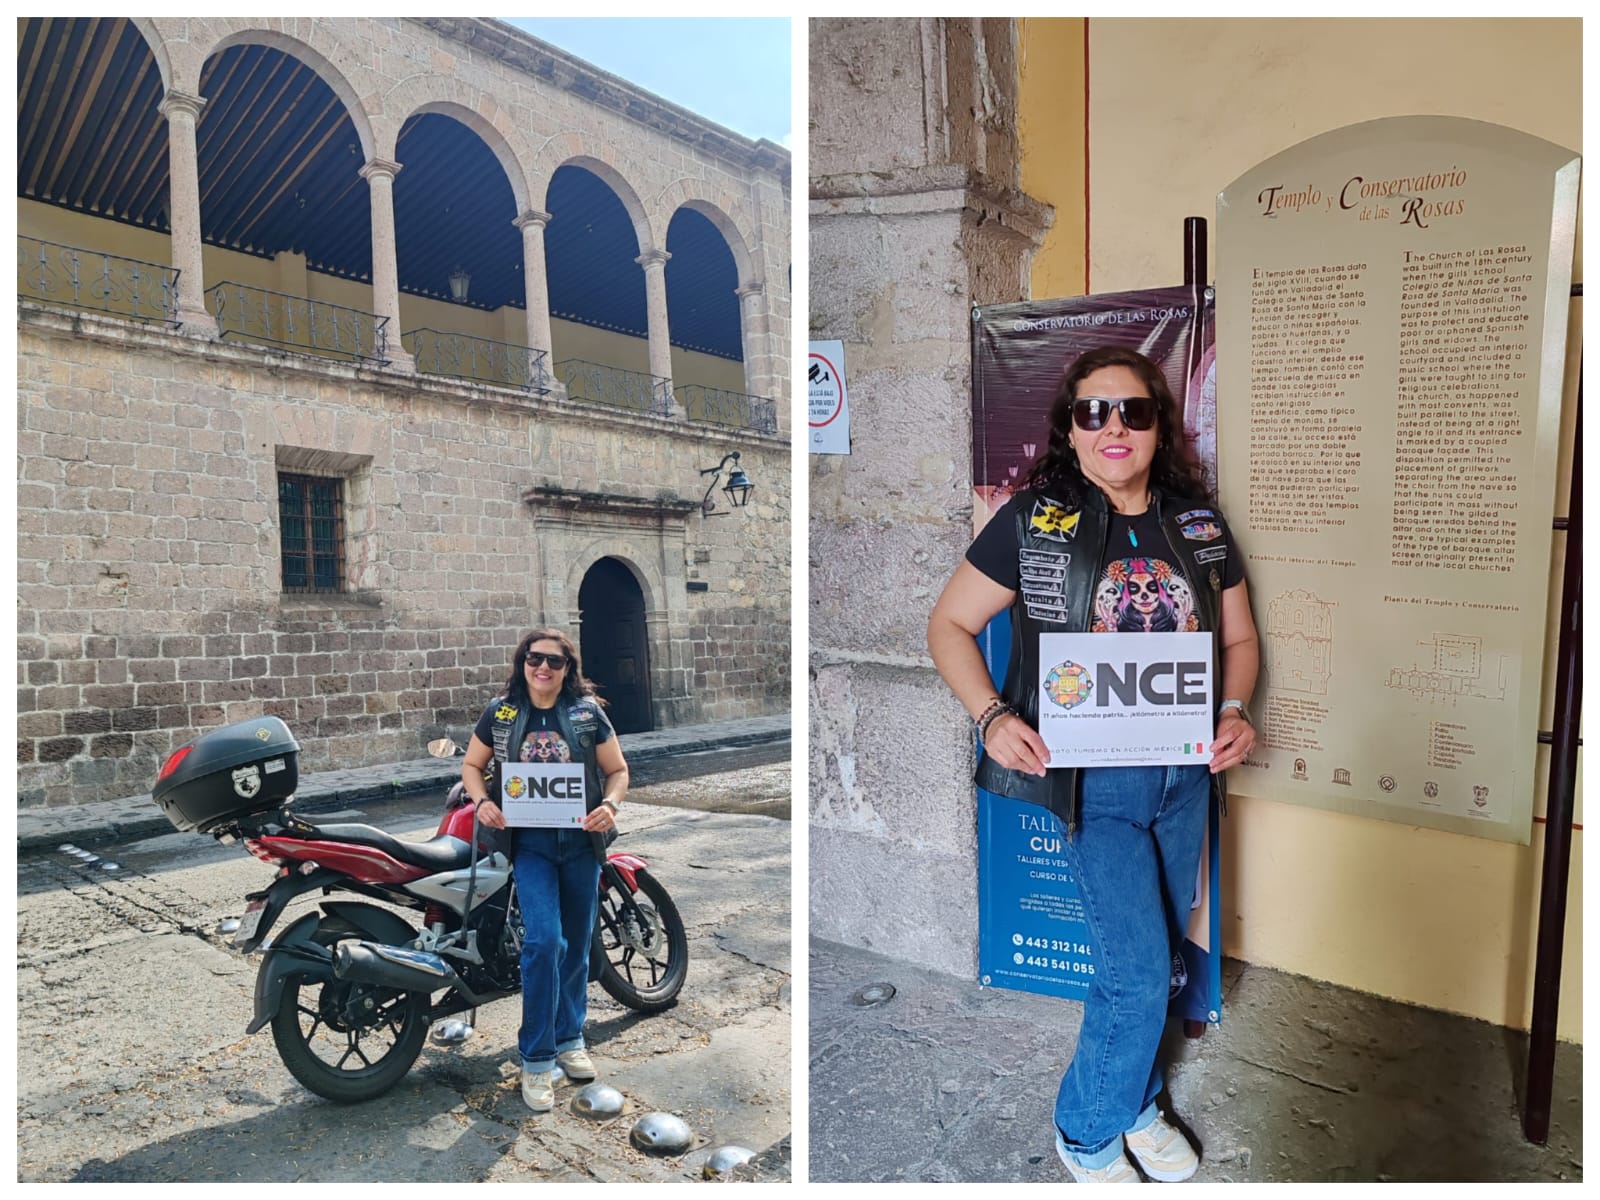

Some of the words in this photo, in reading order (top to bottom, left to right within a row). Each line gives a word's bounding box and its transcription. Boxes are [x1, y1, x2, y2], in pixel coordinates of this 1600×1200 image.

[1258, 184, 1321, 216] Templo
[1325, 196, 1332, 212] y
[1340, 166, 1466, 210] Conservatorio
[1359, 207, 1370, 220] de
[1375, 205, 1389, 219] las
[1400, 198, 1464, 228] Rosas
[1429, 251, 1462, 260] Church
[1479, 247, 1493, 256] Las
[1498, 245, 1525, 254] Rosas
[1422, 261, 1441, 270] built
[1444, 260, 1452, 268] in
[1455, 259, 1469, 267] the
[1474, 257, 1492, 266] 18th
[1496, 254, 1531, 266] century
[1266, 269, 1293, 279] Templo
[1296, 267, 1304, 276] de
[1308, 266, 1318, 274] las
[1322, 264, 1344, 273] Rosas
[1347, 262, 1366, 271] data
[1402, 272, 1426, 281] when
[1430, 270, 1444, 279] the
[1474, 266, 1505, 275] school
[1252, 279, 1264, 288] del
[1268, 277, 1286, 288] siglo
[1315, 273, 1346, 282] cuando
[1291, 282, 1332, 292] Valladolid
[1336, 280, 1343, 289] el
[1402, 281, 1438, 292] Colegio
[1442, 279, 1453, 288] de
[1487, 275, 1499, 284] de
[1504, 273, 1531, 282] Santa
[1252, 295, 1283, 306] Colegio
[1287, 294, 1296, 302] de
[1326, 291, 1336, 300] de
[1340, 290, 1363, 299] Santa
[1402, 291, 1423, 300] Rosa
[1427, 290, 1438, 298] de
[1442, 288, 1468, 297] Santa
[1252, 304, 1270, 313] Rosa
[1273, 303, 1283, 312] de
[1287, 302, 1309, 311] Santa
[1358, 298, 1365, 307] la
[1401, 300, 1439, 309] founded
[1443, 298, 1450, 307] in
[1108, 313, 1122, 323] DE
[1127, 312, 1145, 322] LAS
[1284, 312, 1294, 320] de
[1298, 312, 1330, 321] recoger
[1401, 310, 1437, 319] purpose
[1442, 307, 1450, 315] of
[1454, 306, 1469, 315] this
[1473, 304, 1520, 313] institution
[1252, 321, 1279, 330] educar
[1291, 319, 1312, 328] niñas
[1420, 318, 1428, 326] to
[1432, 316, 1464, 327] protect
[1468, 315, 1485, 324] and
[1489, 313, 1528, 322] educate
[1251, 399, 1273, 407] canto
[1276, 398, 1310, 409] religioso
[1251, 441, 1285, 449] marcado
[1322, 441, 1346, 449] doble
[1394, 490, 1411, 498] that
[1414, 490, 1428, 498] the
[1456, 491, 1482, 499] could
[1250, 522, 1280, 531] retablos
[1392, 560, 1411, 568] most
[1415, 560, 1422, 569] of
[1426, 561, 1439, 569] the
[1443, 562, 1465, 570] local
[1017, 855, 1050, 866] TALLERES
[1030, 871, 1056, 880] CURSO
[1058, 873, 1067, 881] DE
[1026, 937, 1048, 949] 443
[1051, 940, 1070, 952] 312
[1026, 956, 1048, 968] 443
[1051, 959, 1070, 971] 541
[1073, 962, 1095, 974] 055
